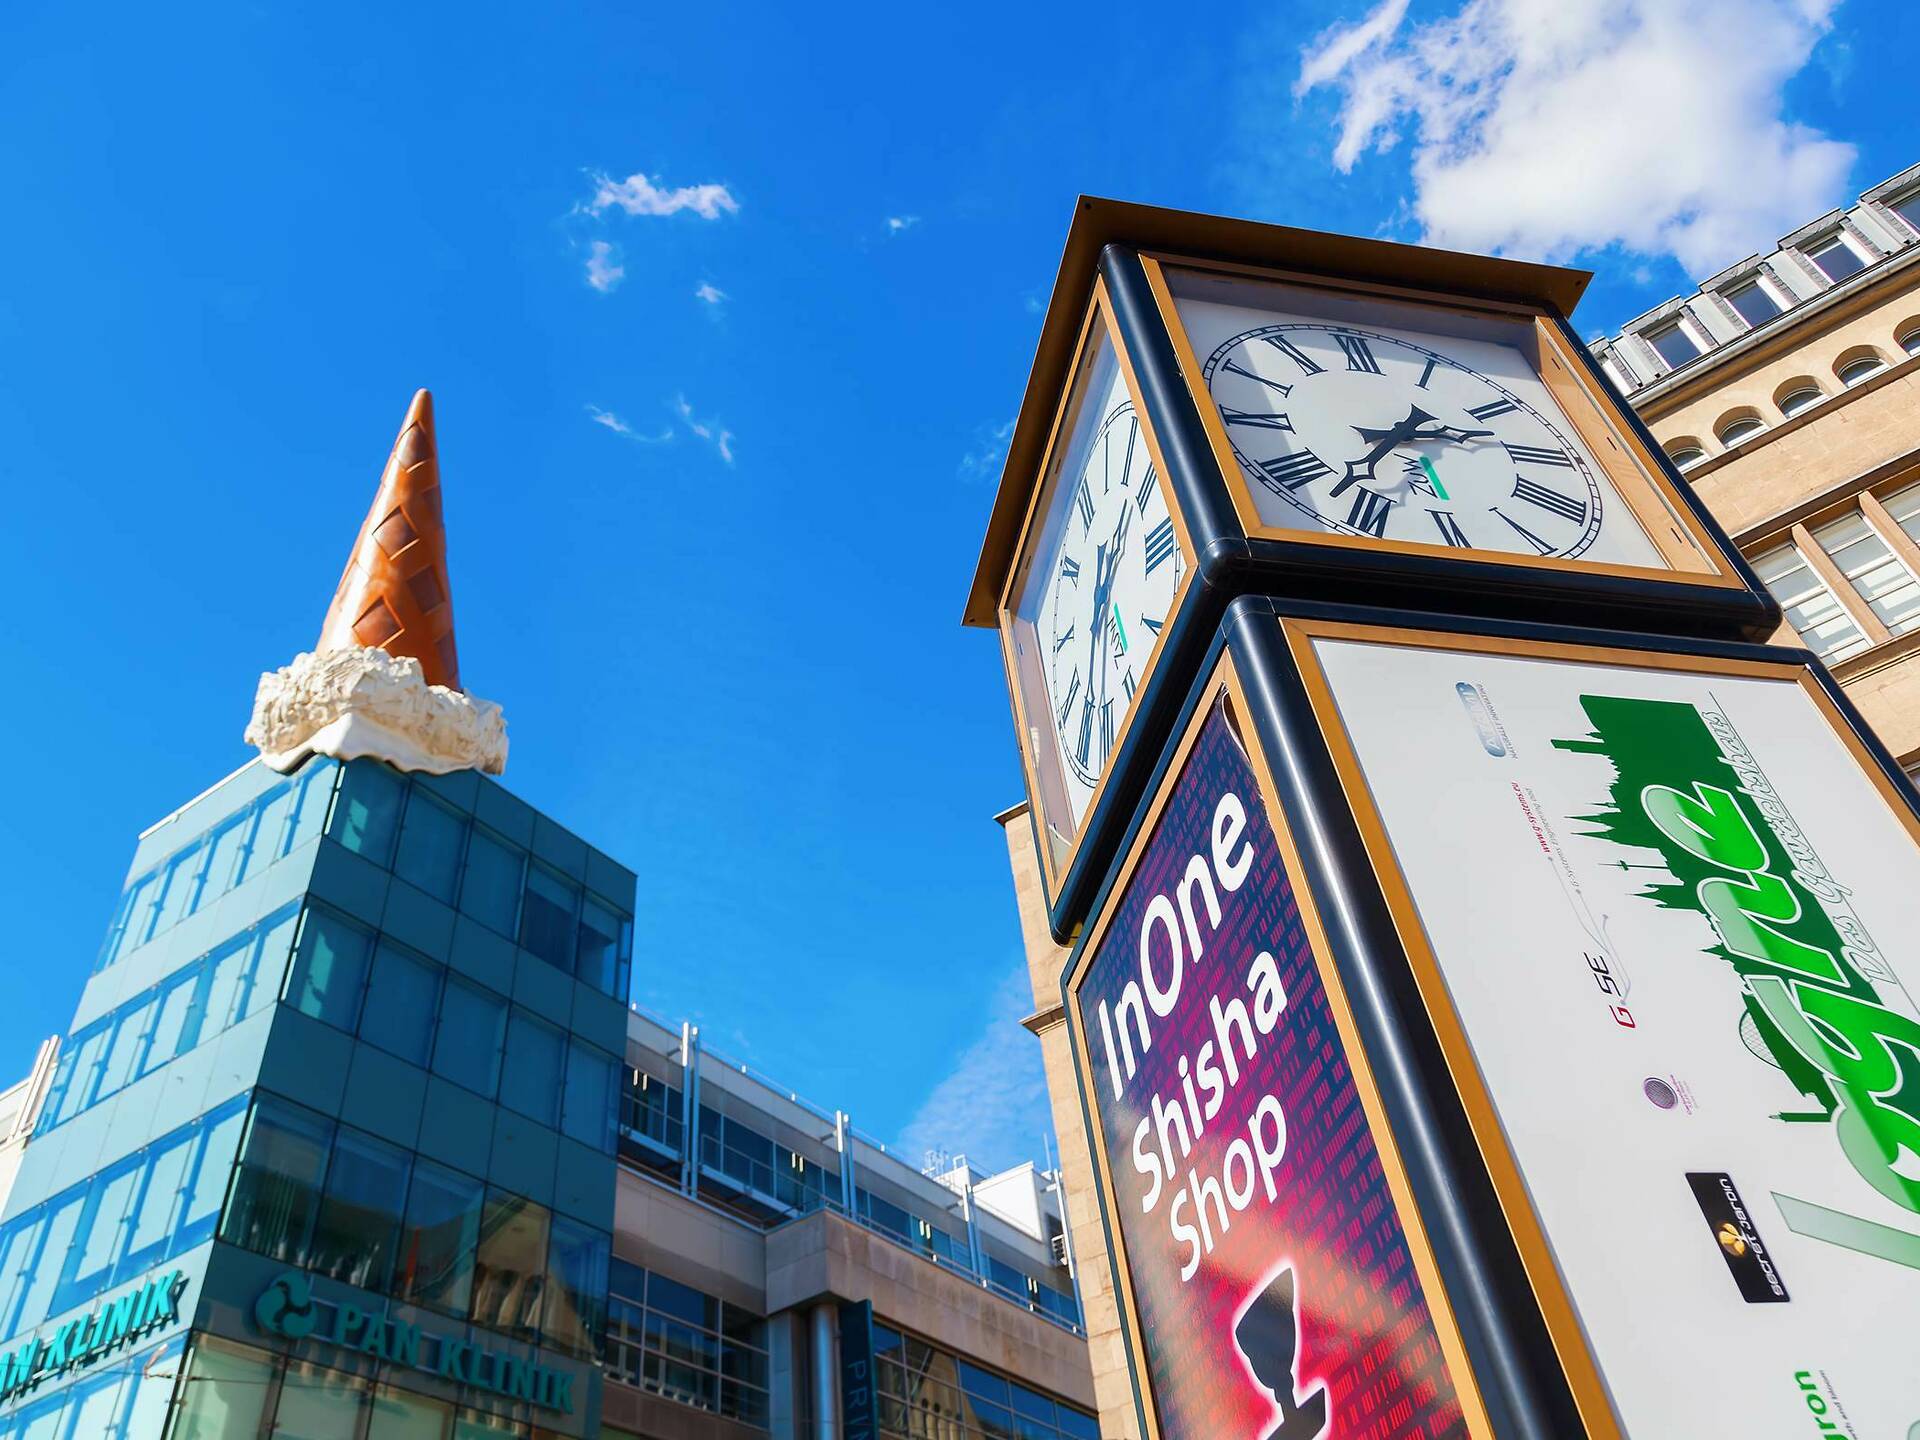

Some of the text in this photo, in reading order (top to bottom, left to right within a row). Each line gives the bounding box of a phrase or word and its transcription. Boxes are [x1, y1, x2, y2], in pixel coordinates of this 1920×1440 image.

[1261, 334, 1328, 376] XI
[1328, 332, 1386, 376] XII
[1463, 397, 1523, 423] II
[1500, 440, 1577, 471] III
[1098, 792, 1255, 1102] InOne
[45, 1269, 182, 1370] KLINIK
[334, 1302, 576, 1415] PAN KLINIK
